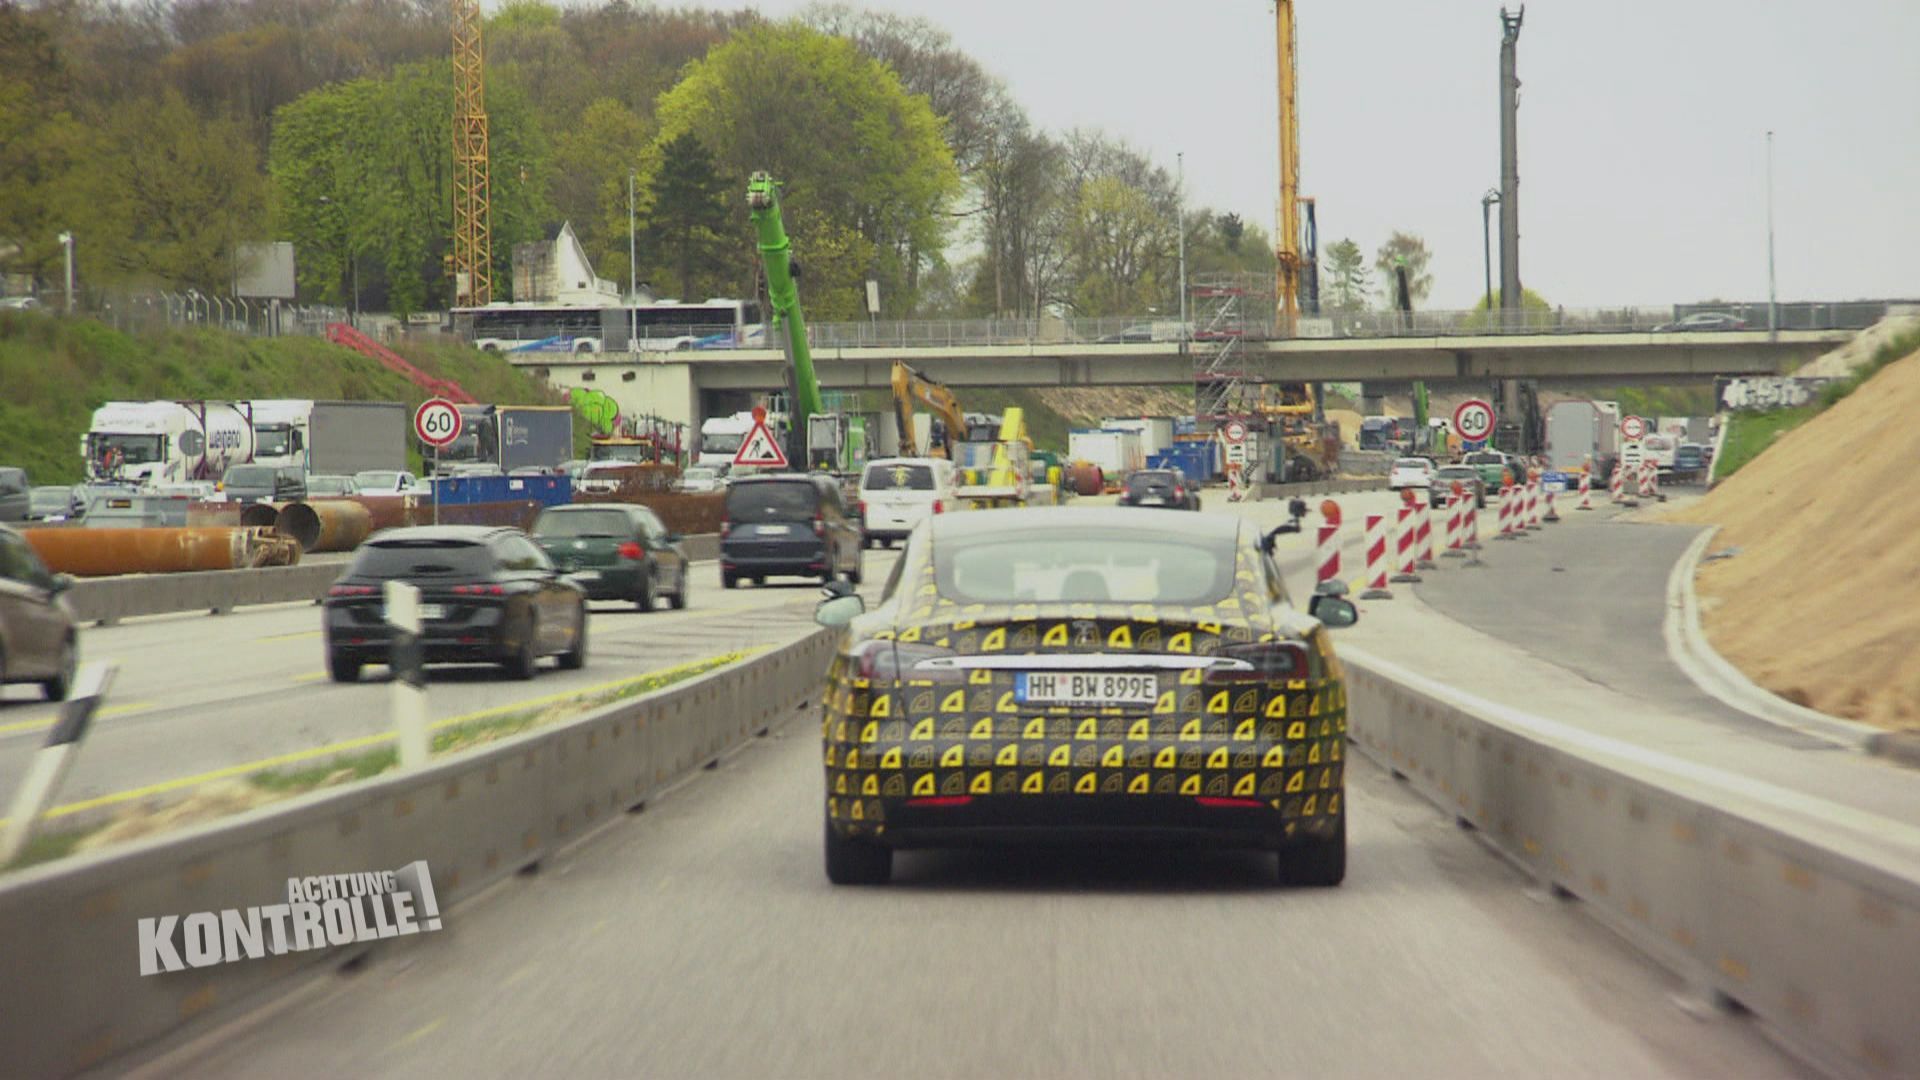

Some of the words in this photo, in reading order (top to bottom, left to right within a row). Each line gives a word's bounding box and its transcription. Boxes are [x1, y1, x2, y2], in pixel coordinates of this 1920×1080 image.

[426, 412, 451, 433] 60
[1462, 411, 1487, 430] 60
[1029, 676, 1056, 697] HH
[1072, 676, 1098, 698] BW
[1103, 677, 1154, 699] 899E
